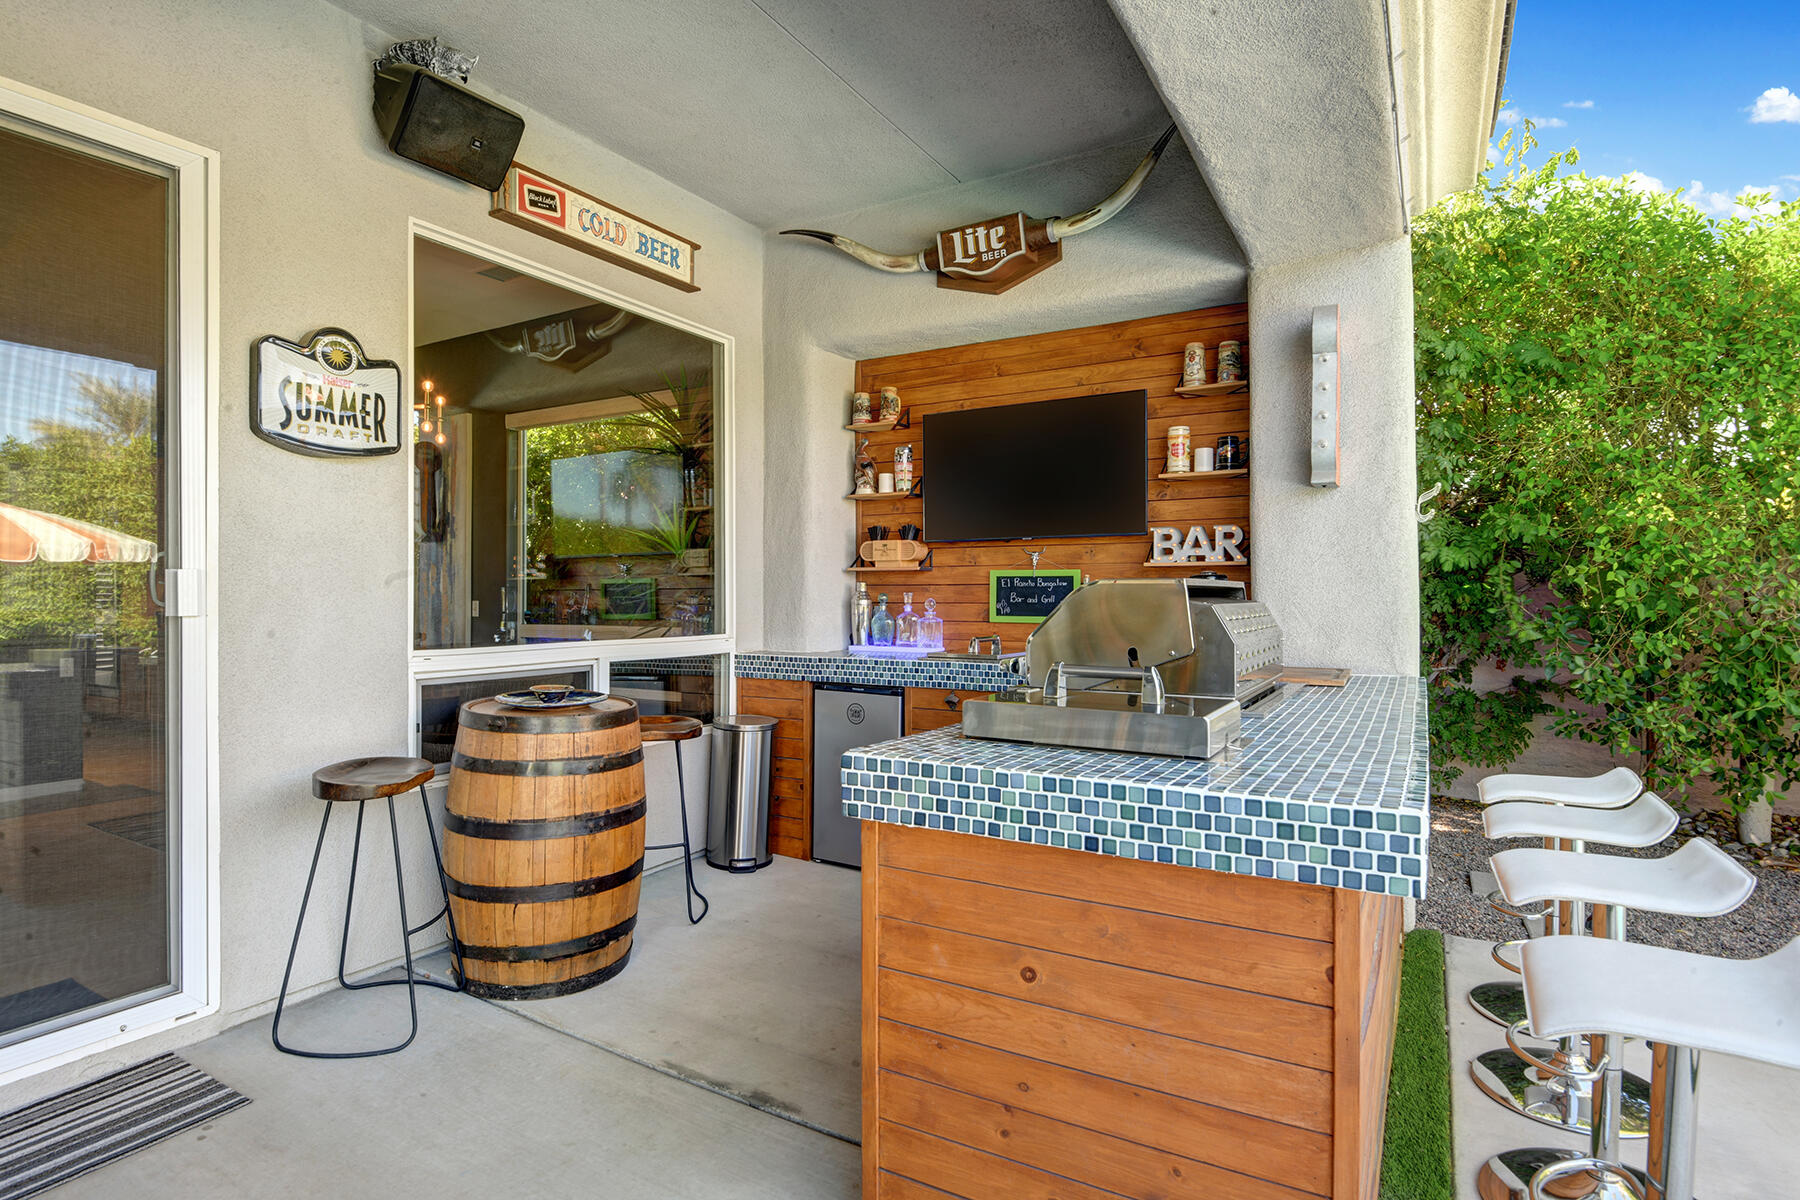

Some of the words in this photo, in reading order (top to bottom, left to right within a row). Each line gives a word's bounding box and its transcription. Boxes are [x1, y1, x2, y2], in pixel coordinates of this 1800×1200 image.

[578, 207, 627, 246] COLD
[635, 231, 681, 270] BEER
[949, 225, 1007, 264] Lite
[982, 248, 1007, 262] BEER
[278, 375, 387, 443] SUMMER
[296, 423, 373, 443] DRAFT
[1150, 524, 1247, 563] BAR
[1001, 579, 1011, 588] El
[1010, 592, 1025, 603] Bar
[1027, 594, 1038, 603] and
[1041, 594, 1056, 604] Grill
